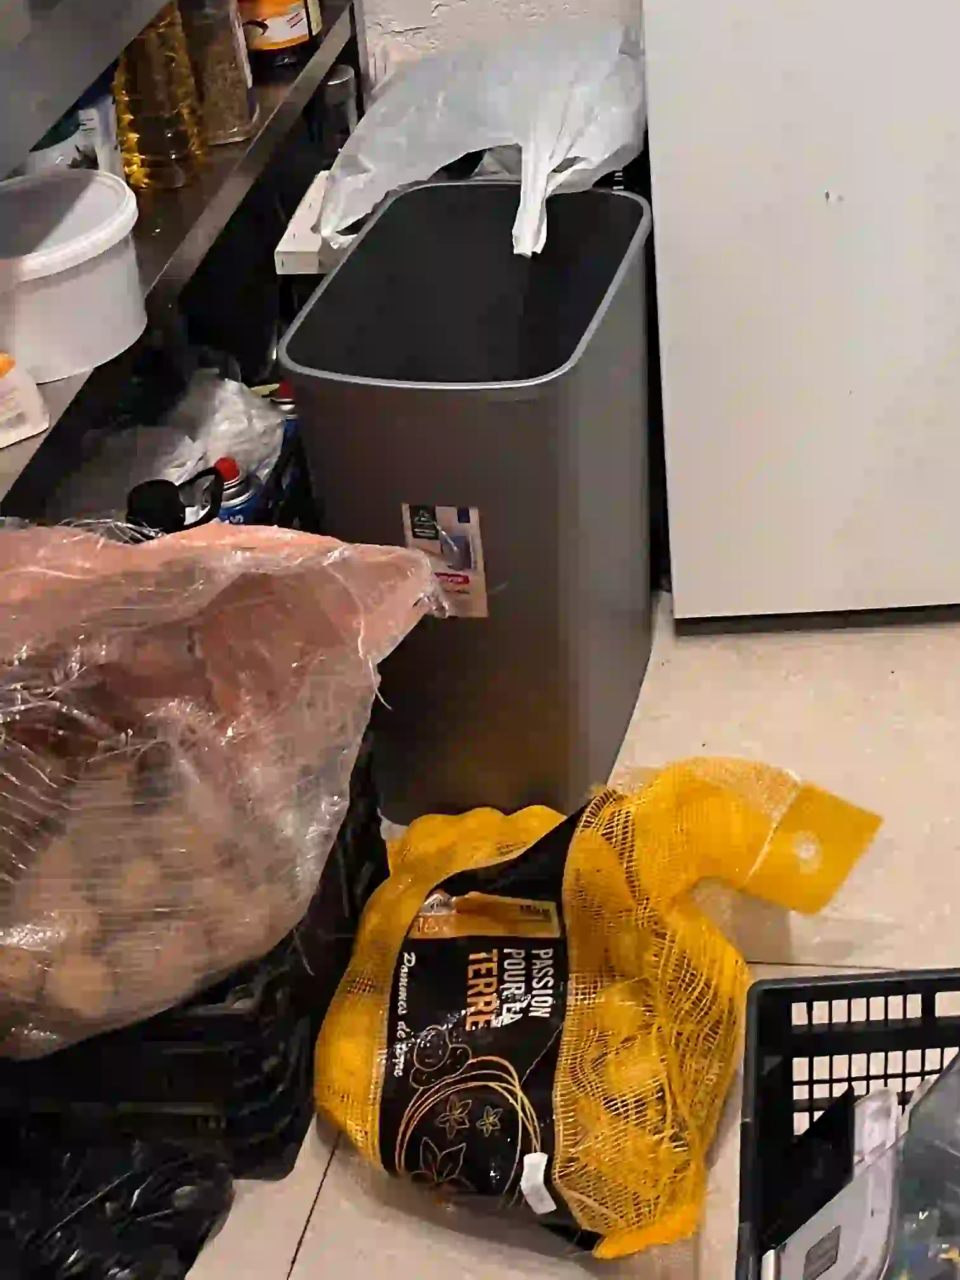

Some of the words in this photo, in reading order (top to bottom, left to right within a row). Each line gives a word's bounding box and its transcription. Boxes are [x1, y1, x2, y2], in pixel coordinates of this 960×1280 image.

[465, 948, 499, 1032] TERRE
[500, 947, 526, 999] POUR
[528, 947, 555, 1018] PASSION
[397, 1021, 411, 1039] de
